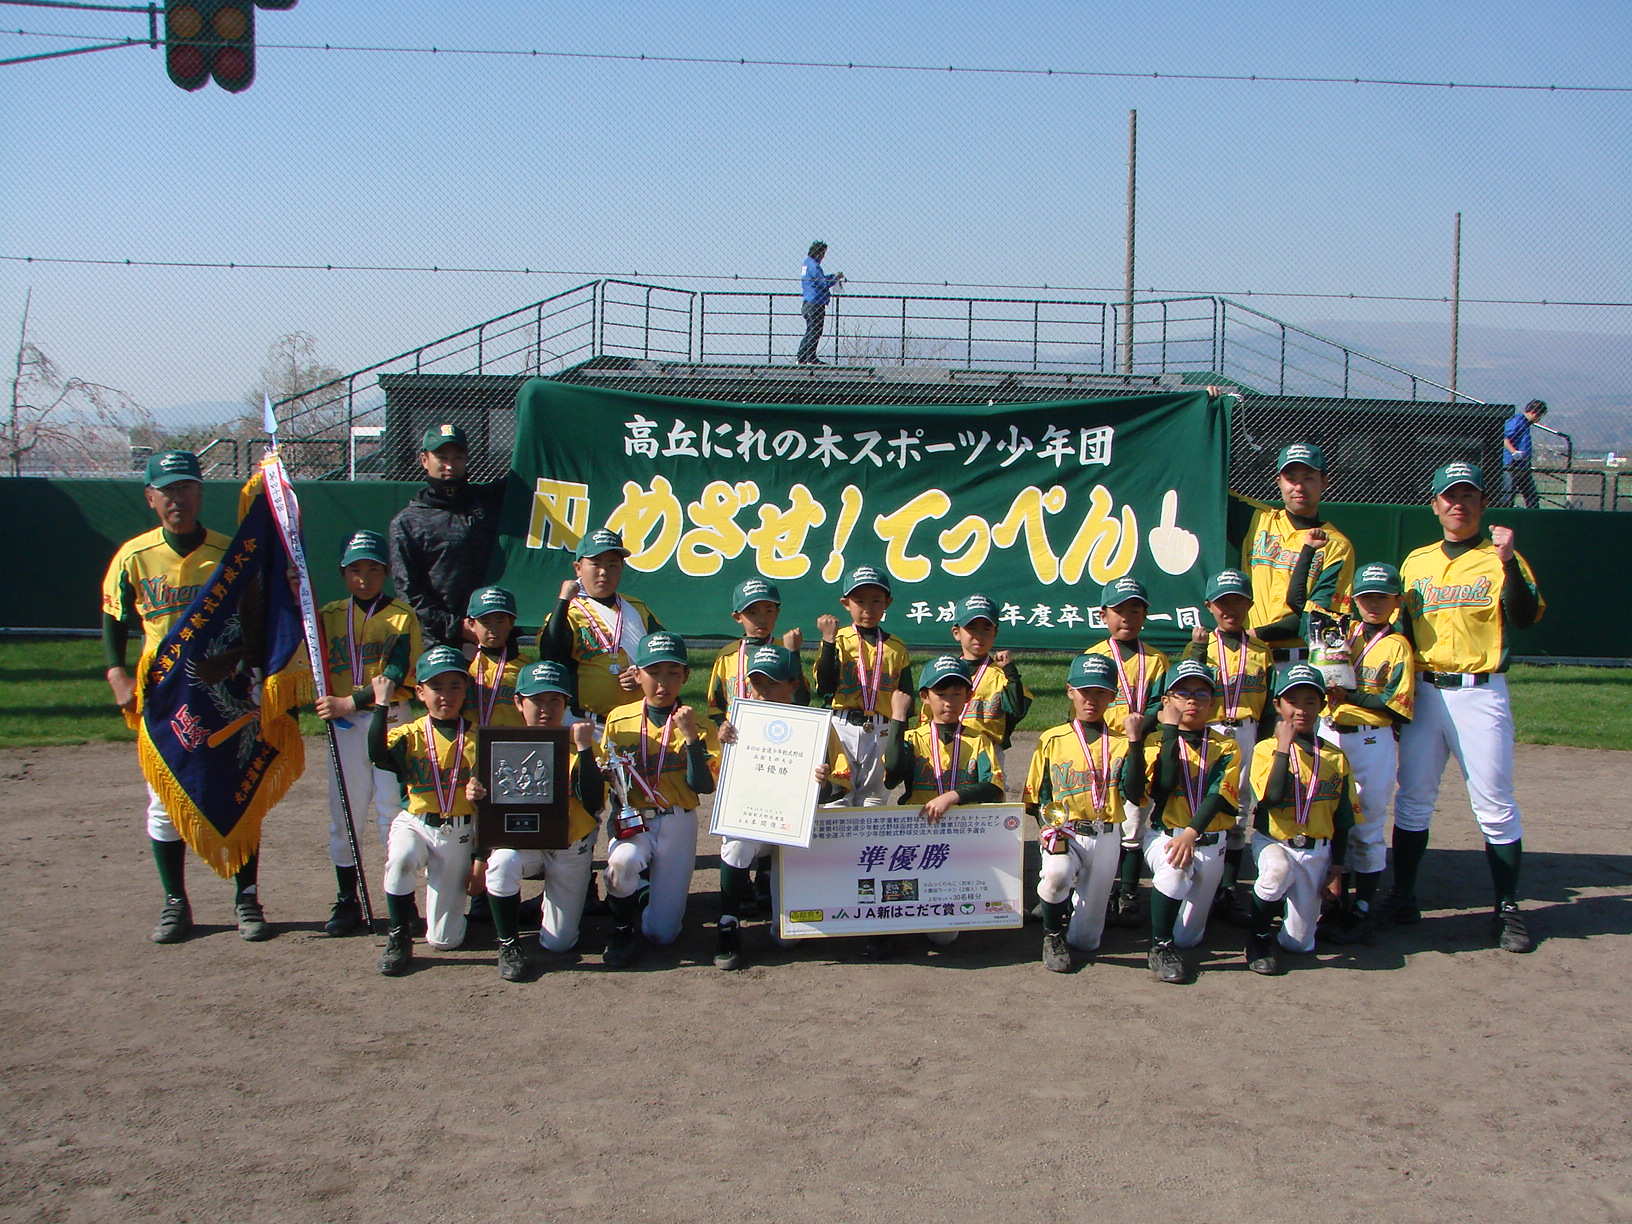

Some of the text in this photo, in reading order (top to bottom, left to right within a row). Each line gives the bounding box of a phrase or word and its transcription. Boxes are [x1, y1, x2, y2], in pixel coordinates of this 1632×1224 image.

[623, 414, 1116, 469] 高丘にれの木スポーツ少年団
[1409, 575, 1493, 608] Nirenoki
[756, 763, 789, 776] 準優勝
[857, 843, 951, 873] 準優勝
[853, 902, 956, 919] JA新はこだて賞
